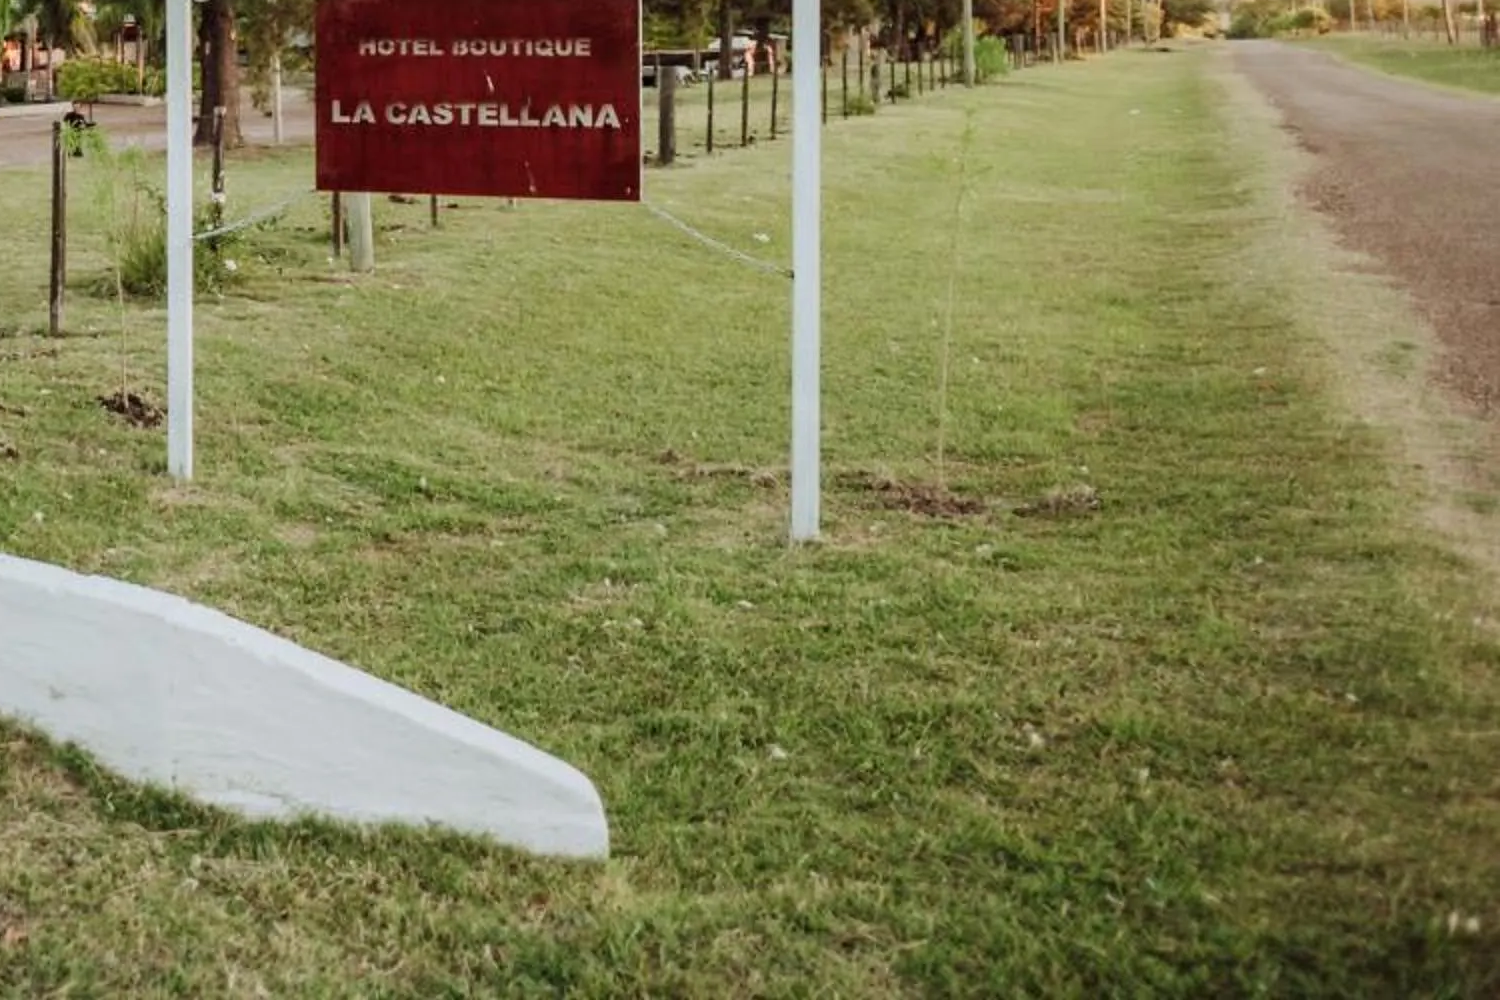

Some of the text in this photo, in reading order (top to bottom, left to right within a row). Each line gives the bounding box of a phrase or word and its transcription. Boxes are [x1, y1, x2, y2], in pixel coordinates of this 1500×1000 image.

[359, 38, 592, 57] HOTEL BOUTIQUE
[331, 99, 621, 128] LA CASTELLANA
